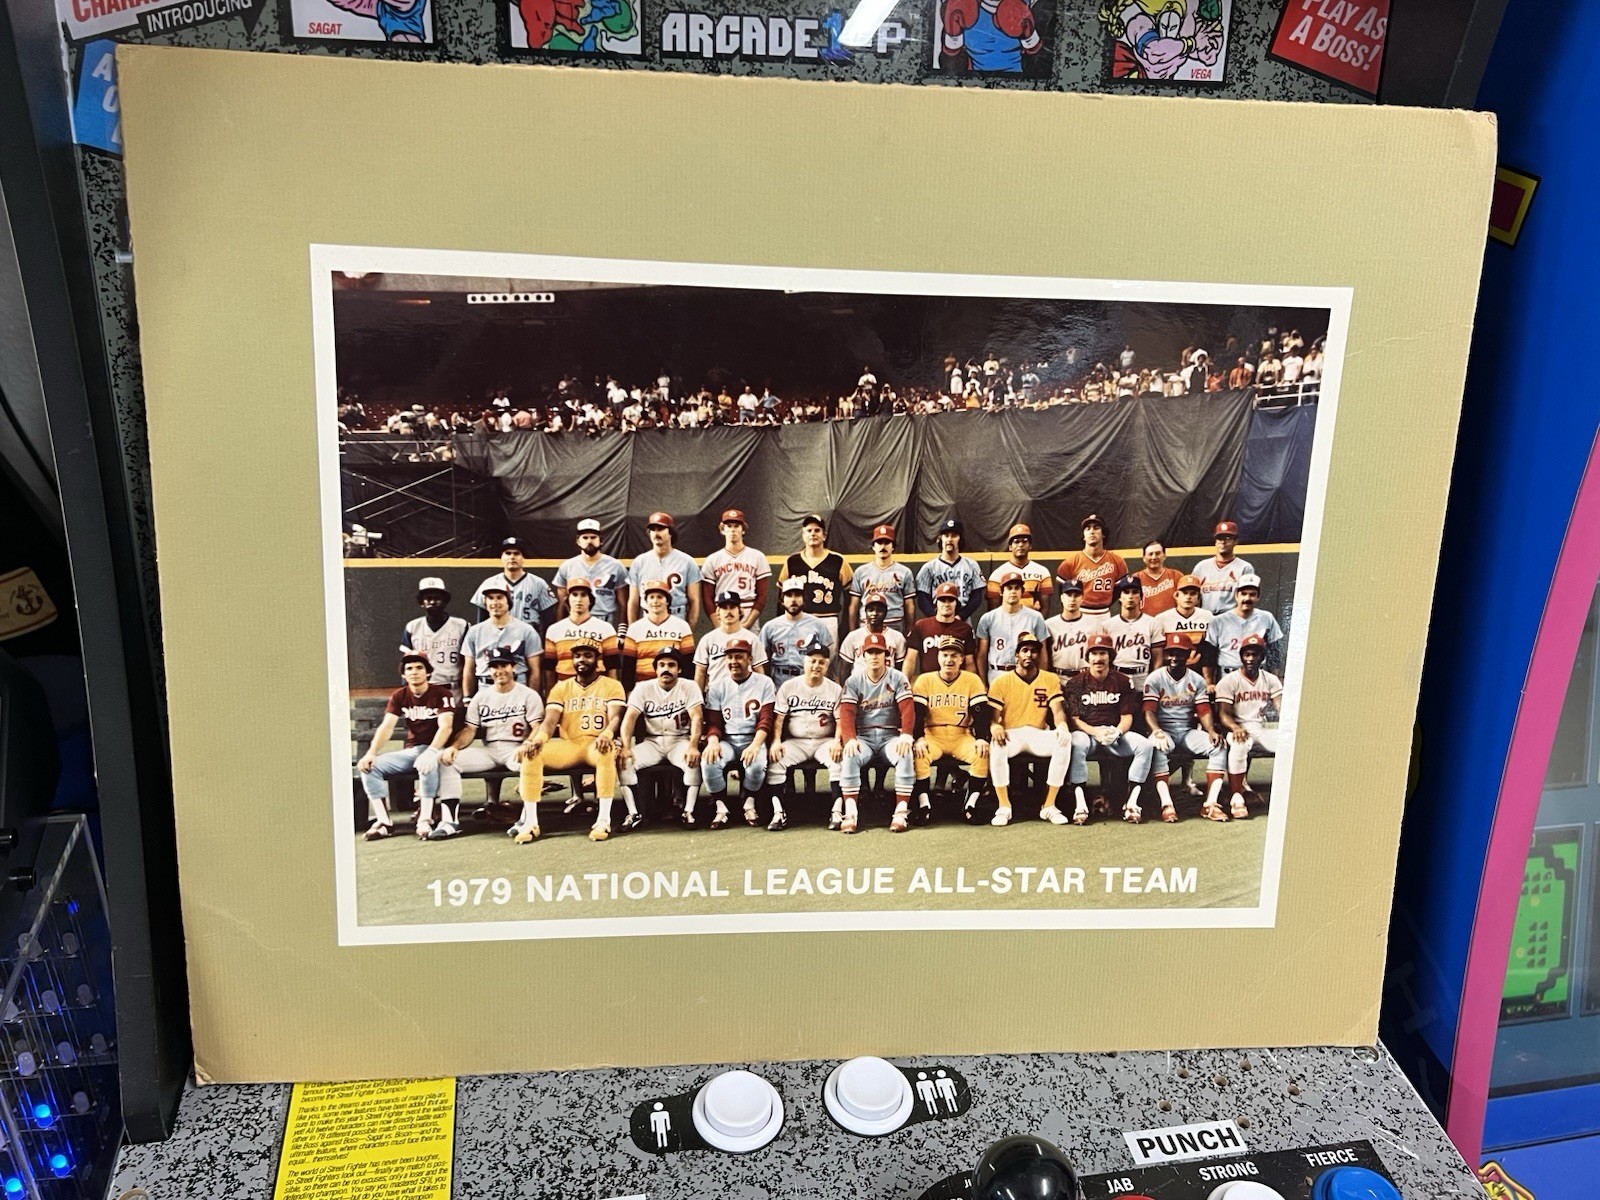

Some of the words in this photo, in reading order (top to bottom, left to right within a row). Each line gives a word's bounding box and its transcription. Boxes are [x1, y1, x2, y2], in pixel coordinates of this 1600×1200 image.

[146, 0, 252, 33] INTRODUCING
[308, 22, 343, 35] SAGAT
[1289, 15, 1314, 46] A
[1311, 23, 1382, 72] BOSS!
[1190, 68, 1212, 80] VEGA
[1093, 577, 1112, 592] 22
[813, 589, 833, 605] 36
[997, 638, 1004, 651] 8
[1053, 632, 1087, 652] Mets
[1115, 633, 1145, 651] Mets
[1231, 639, 1238, 651] 2
[437, 651, 458, 664] 36
[1136, 648, 1150, 660] 16
[723, 707, 731, 721] 3
[743, 698, 761, 720] P
[581, 715, 604, 730] 39
[818, 713, 829, 727] 2
[955, 712, 966, 727] 7
[513, 722, 524, 738] 6
[427, 877, 512, 907] 1979
[527, 870, 730, 903] NATIONAL
[744, 867, 895, 896] LEAGUE
[907, 866, 1085, 894] ALL-STAR
[1099, 867, 1198, 894] TEAM
[1136, 1127, 1240, 1158] PUNCH
[1305, 1148, 1358, 1168] FIERCE
[1199, 1161, 1259, 1182] STRONG
[1106, 1177, 1135, 1194] JAB
